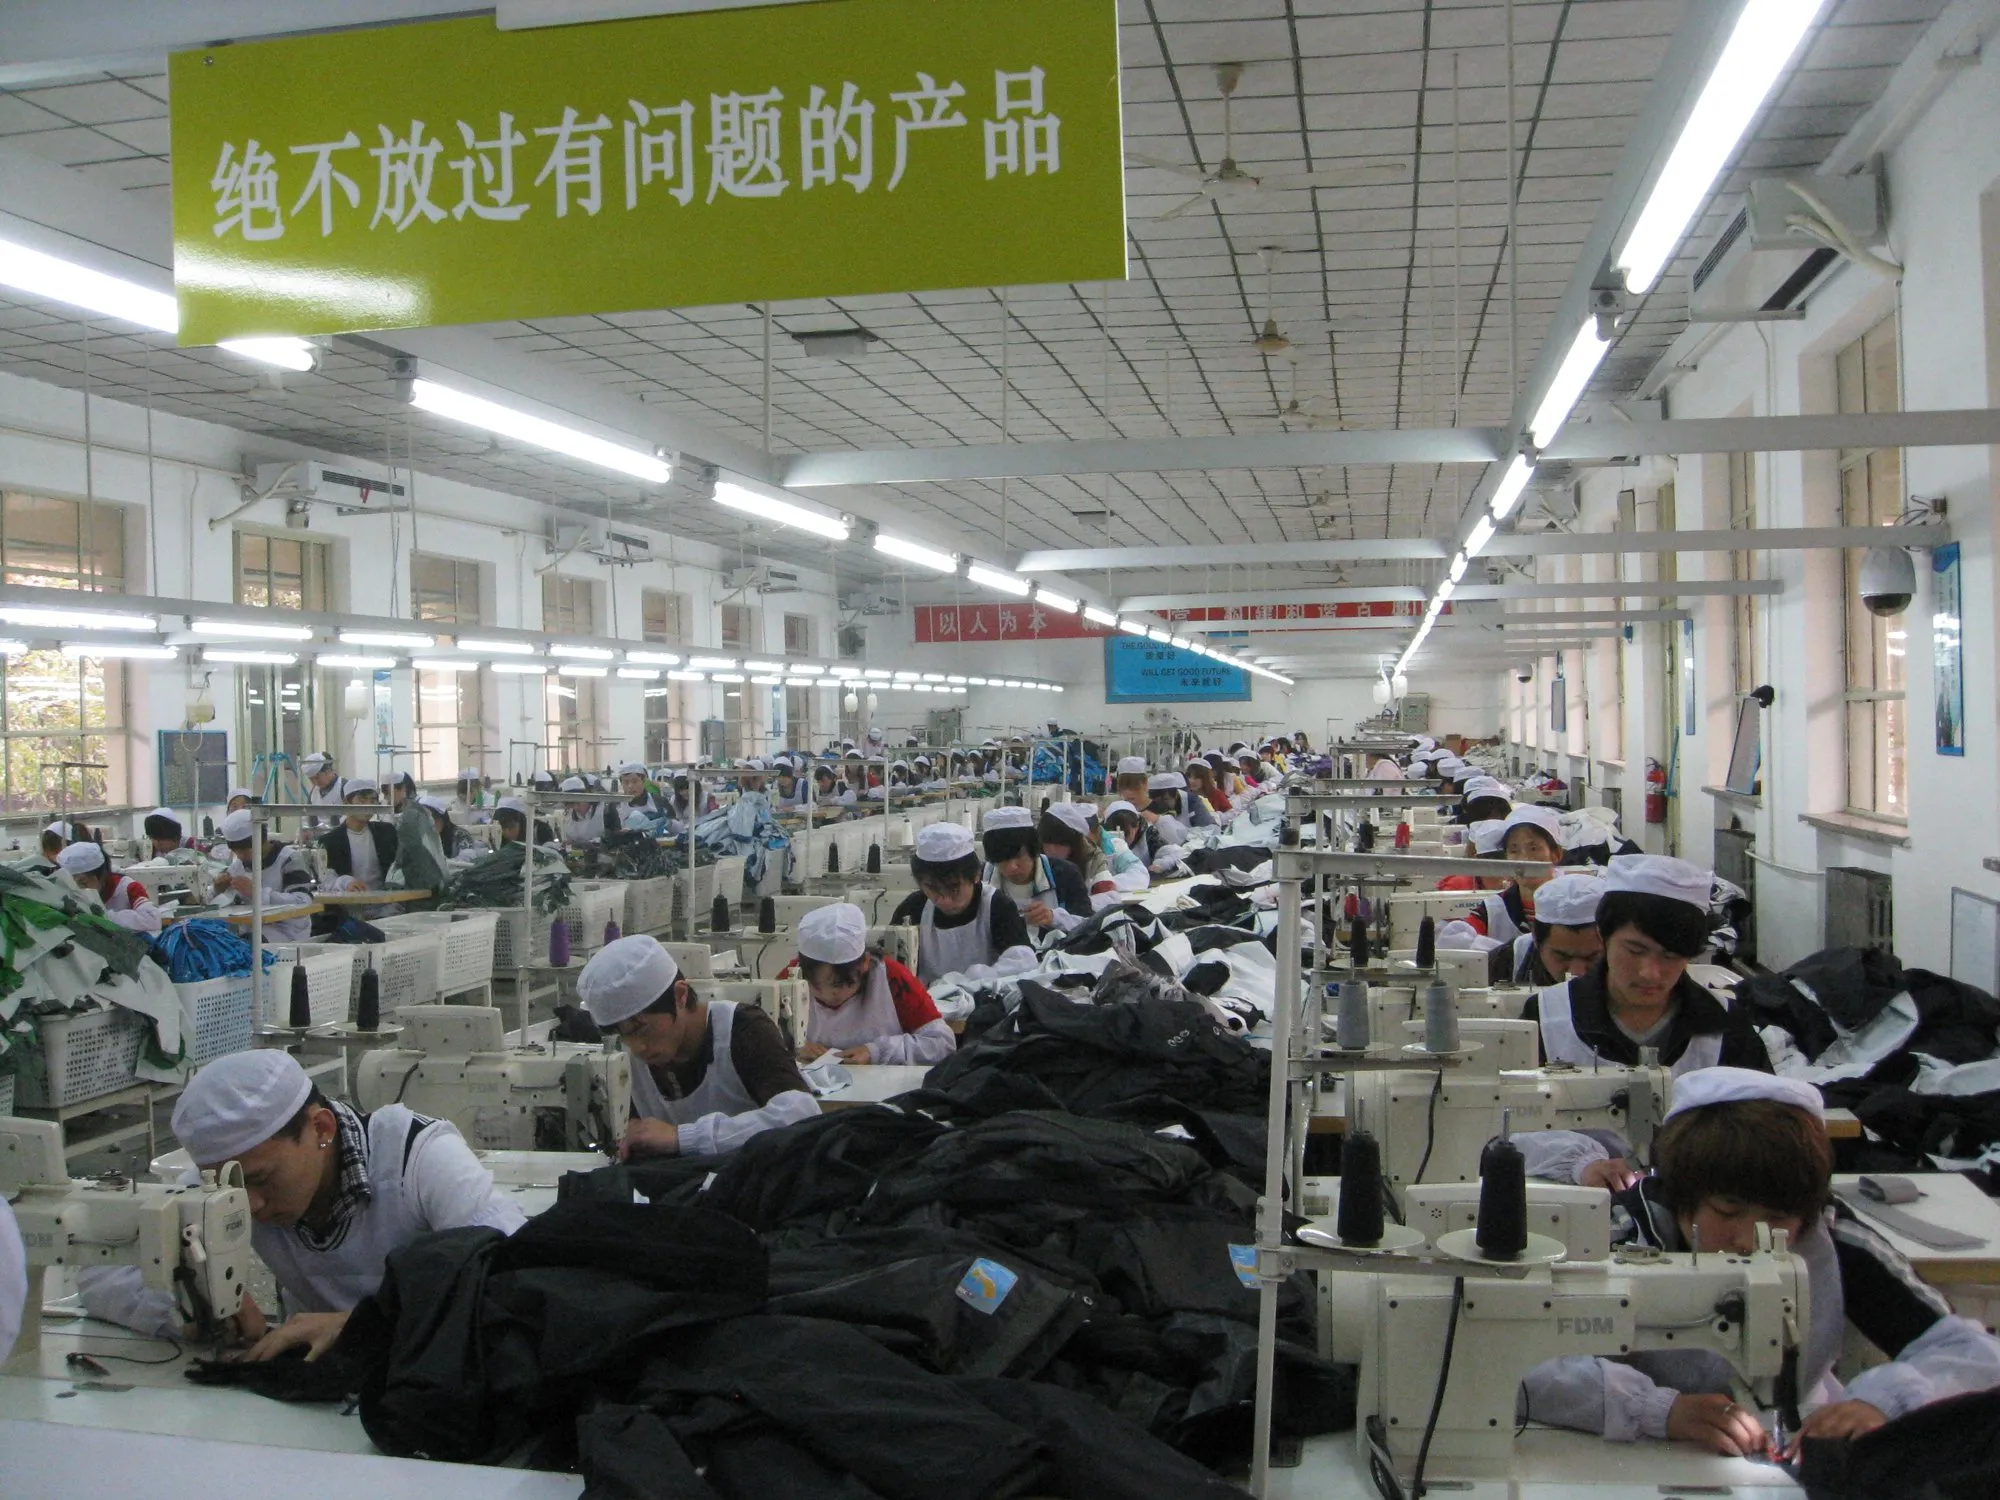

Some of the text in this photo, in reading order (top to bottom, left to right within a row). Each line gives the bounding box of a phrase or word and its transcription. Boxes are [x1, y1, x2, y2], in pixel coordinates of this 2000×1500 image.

[210, 65, 1063, 242] 绝不放过有问题的产品
[938, 609, 1048, 636] 以人为本
[1161, 668, 1176, 676] GET
[1177, 668, 1200, 676] GOOD
[1202, 667, 1232, 676] FUTURE
[1556, 1316, 1614, 1336] FDM
